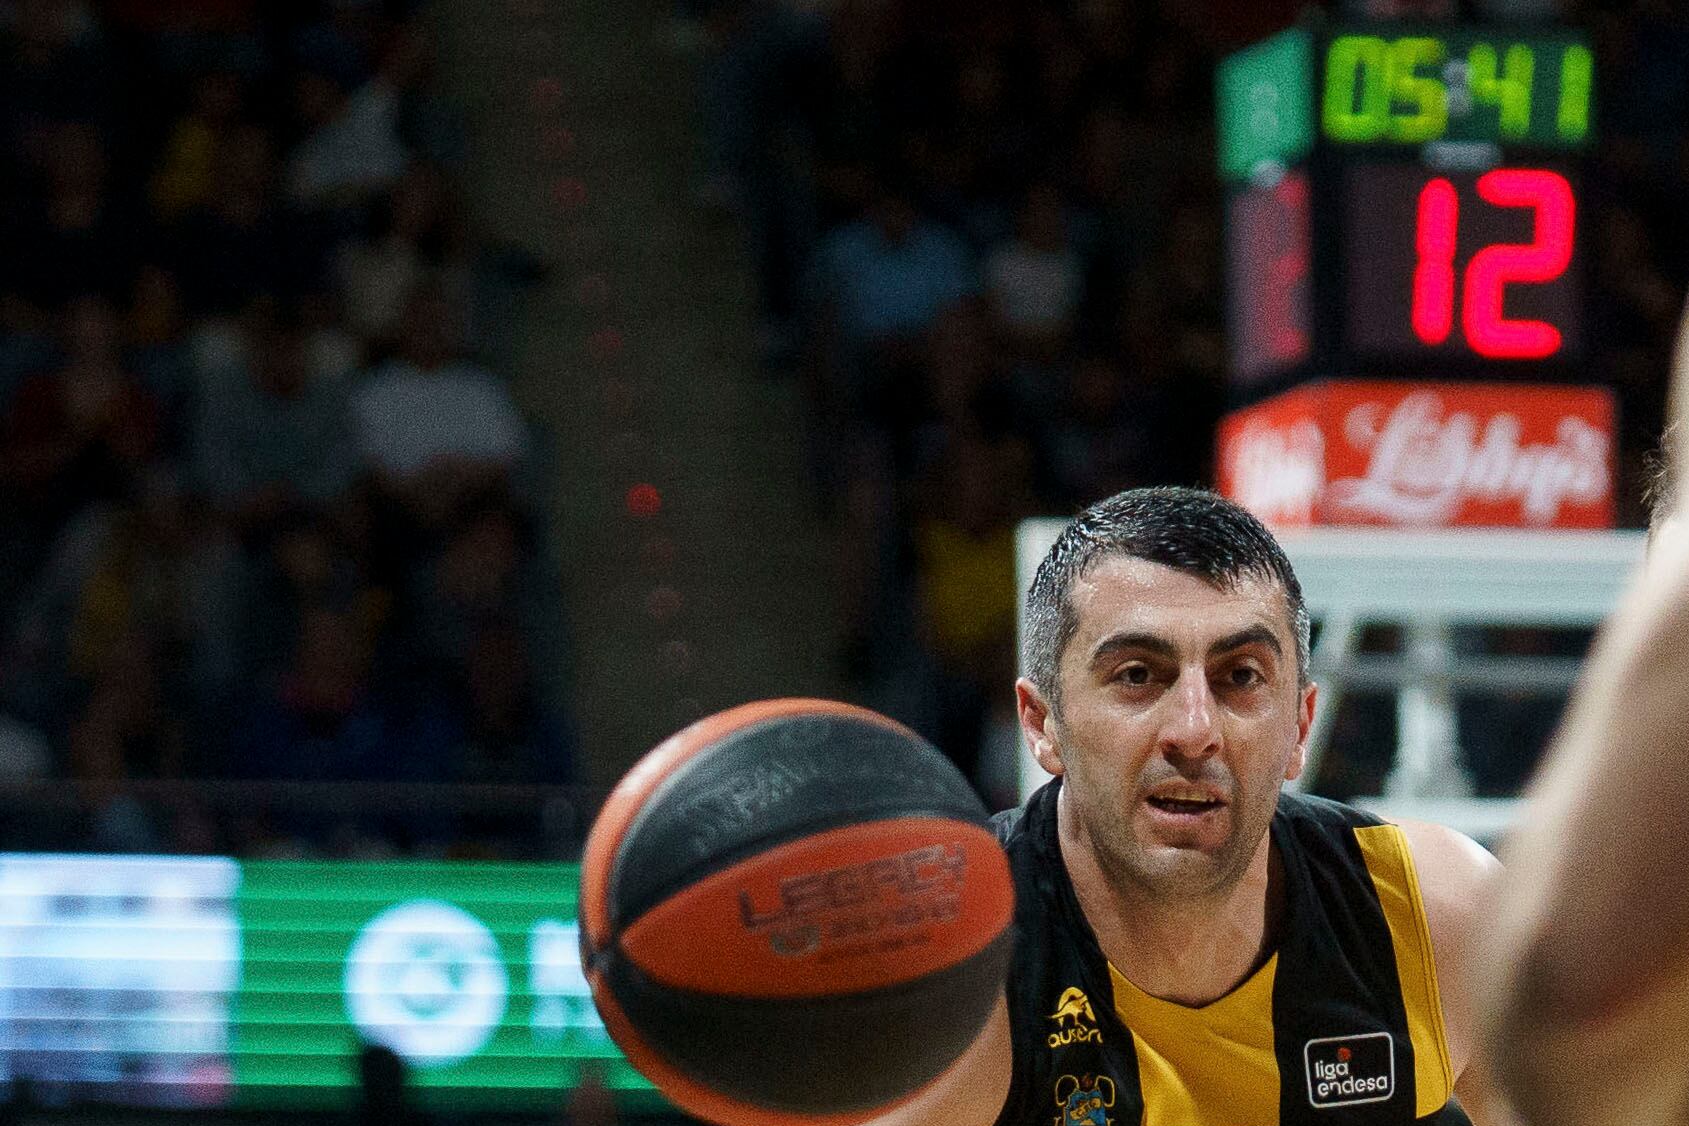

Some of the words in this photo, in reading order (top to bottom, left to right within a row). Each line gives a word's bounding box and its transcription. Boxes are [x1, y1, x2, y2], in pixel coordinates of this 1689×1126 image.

[1410, 167, 1577, 360] 12
[1315, 1058, 1350, 1080] liga
[1316, 1073, 1388, 1098] endesa
